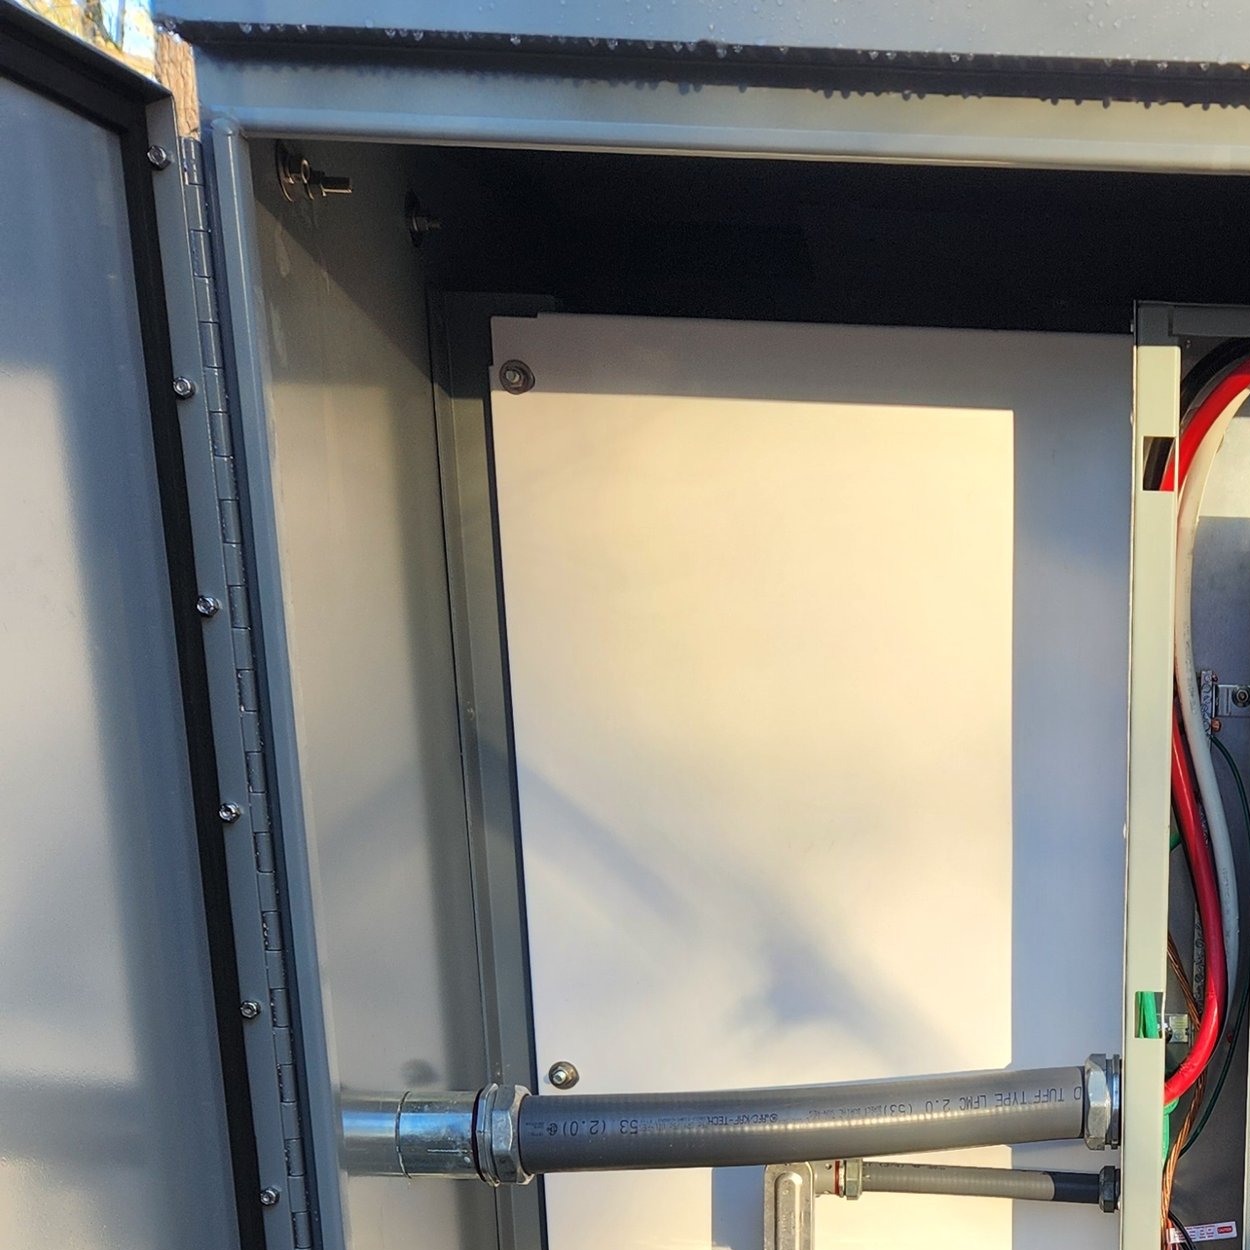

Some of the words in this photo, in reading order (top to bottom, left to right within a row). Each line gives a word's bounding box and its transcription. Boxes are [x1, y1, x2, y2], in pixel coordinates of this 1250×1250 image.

[995, 1091, 1026, 1107] TYPE
[1035, 1087, 1064, 1100] TUFF
[884, 1103, 912, 1116] (53)
[925, 1099, 950, 1113] 2.0
[959, 1095, 987, 1111] LFMC
[562, 1120, 606, 1137] (2.0)
[619, 1119, 638, 1135] 53
